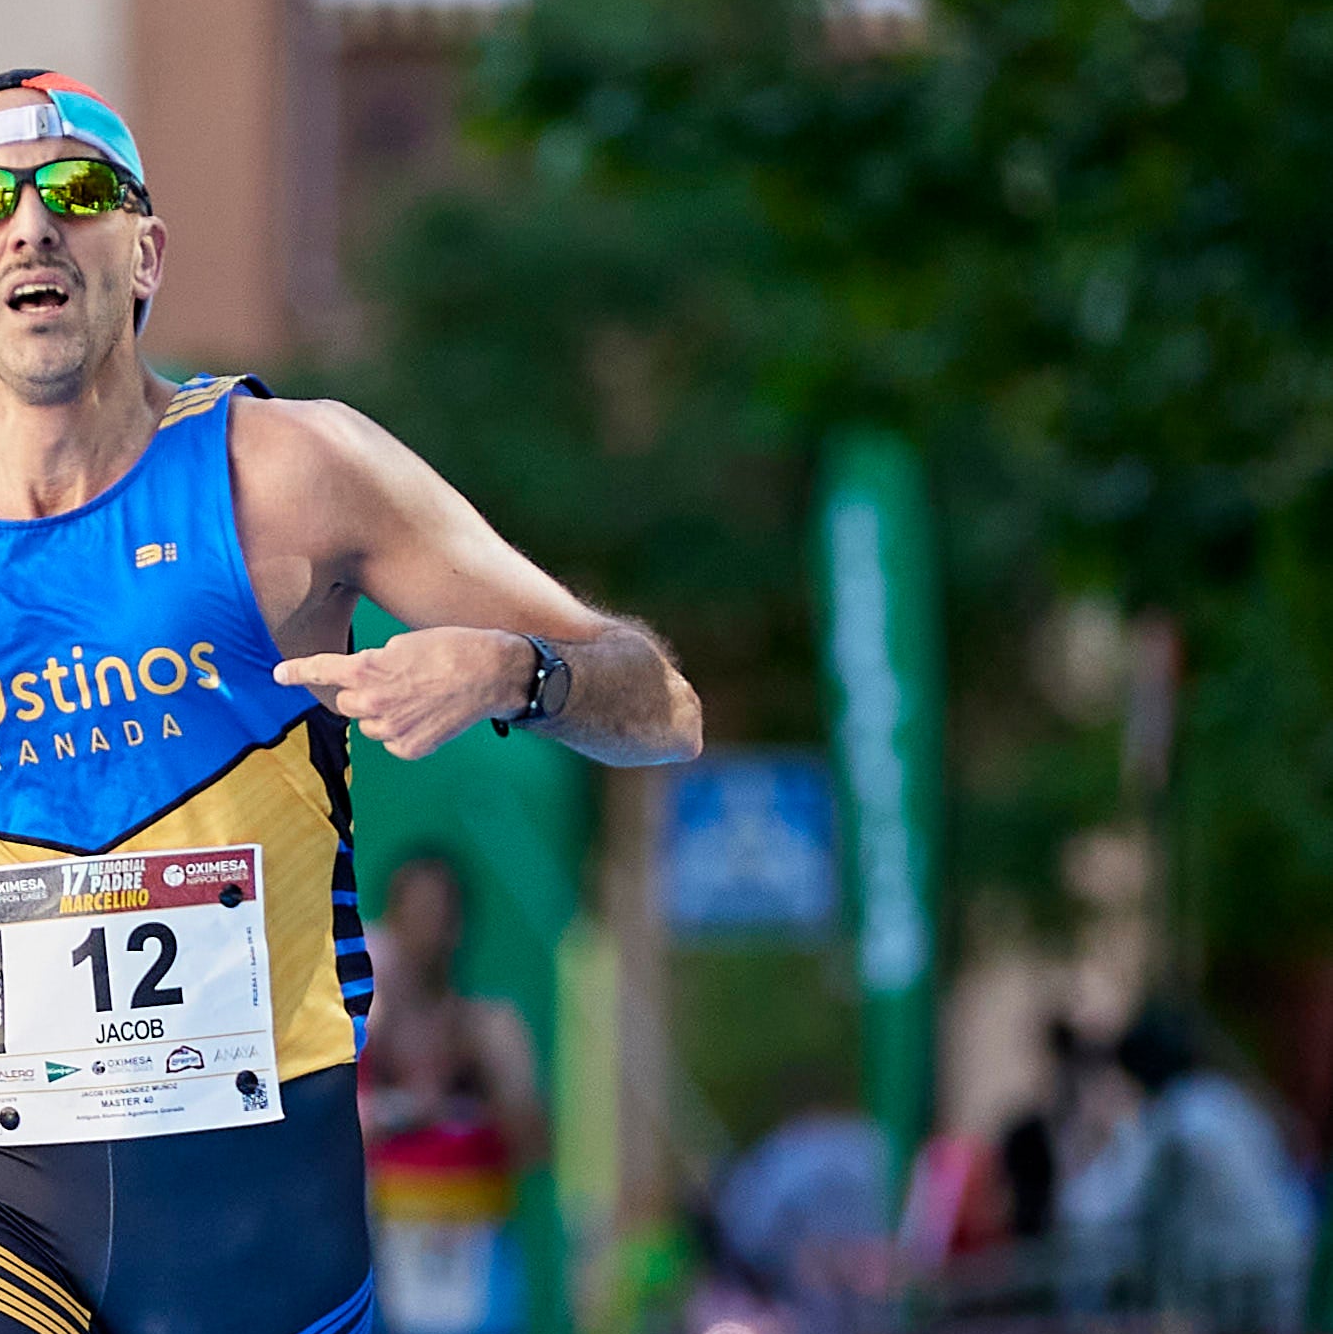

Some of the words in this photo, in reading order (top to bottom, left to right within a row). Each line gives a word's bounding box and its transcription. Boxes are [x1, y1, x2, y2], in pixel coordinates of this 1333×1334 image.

[61, 863, 88, 896] 17
[88, 859, 146, 876] MEMORIAL
[185, 859, 248, 875] OXIMESA
[90, 872, 143, 894] PADRE
[59, 888, 150, 914] MARCELINO
[71, 921, 184, 1014] 12
[95, 1018, 165, 1044] JACOB
[107, 1056, 153, 1068] OXIMESA
[214, 1045, 259, 1063] ANAYA
[101, 1097, 140, 1108] MASTER
